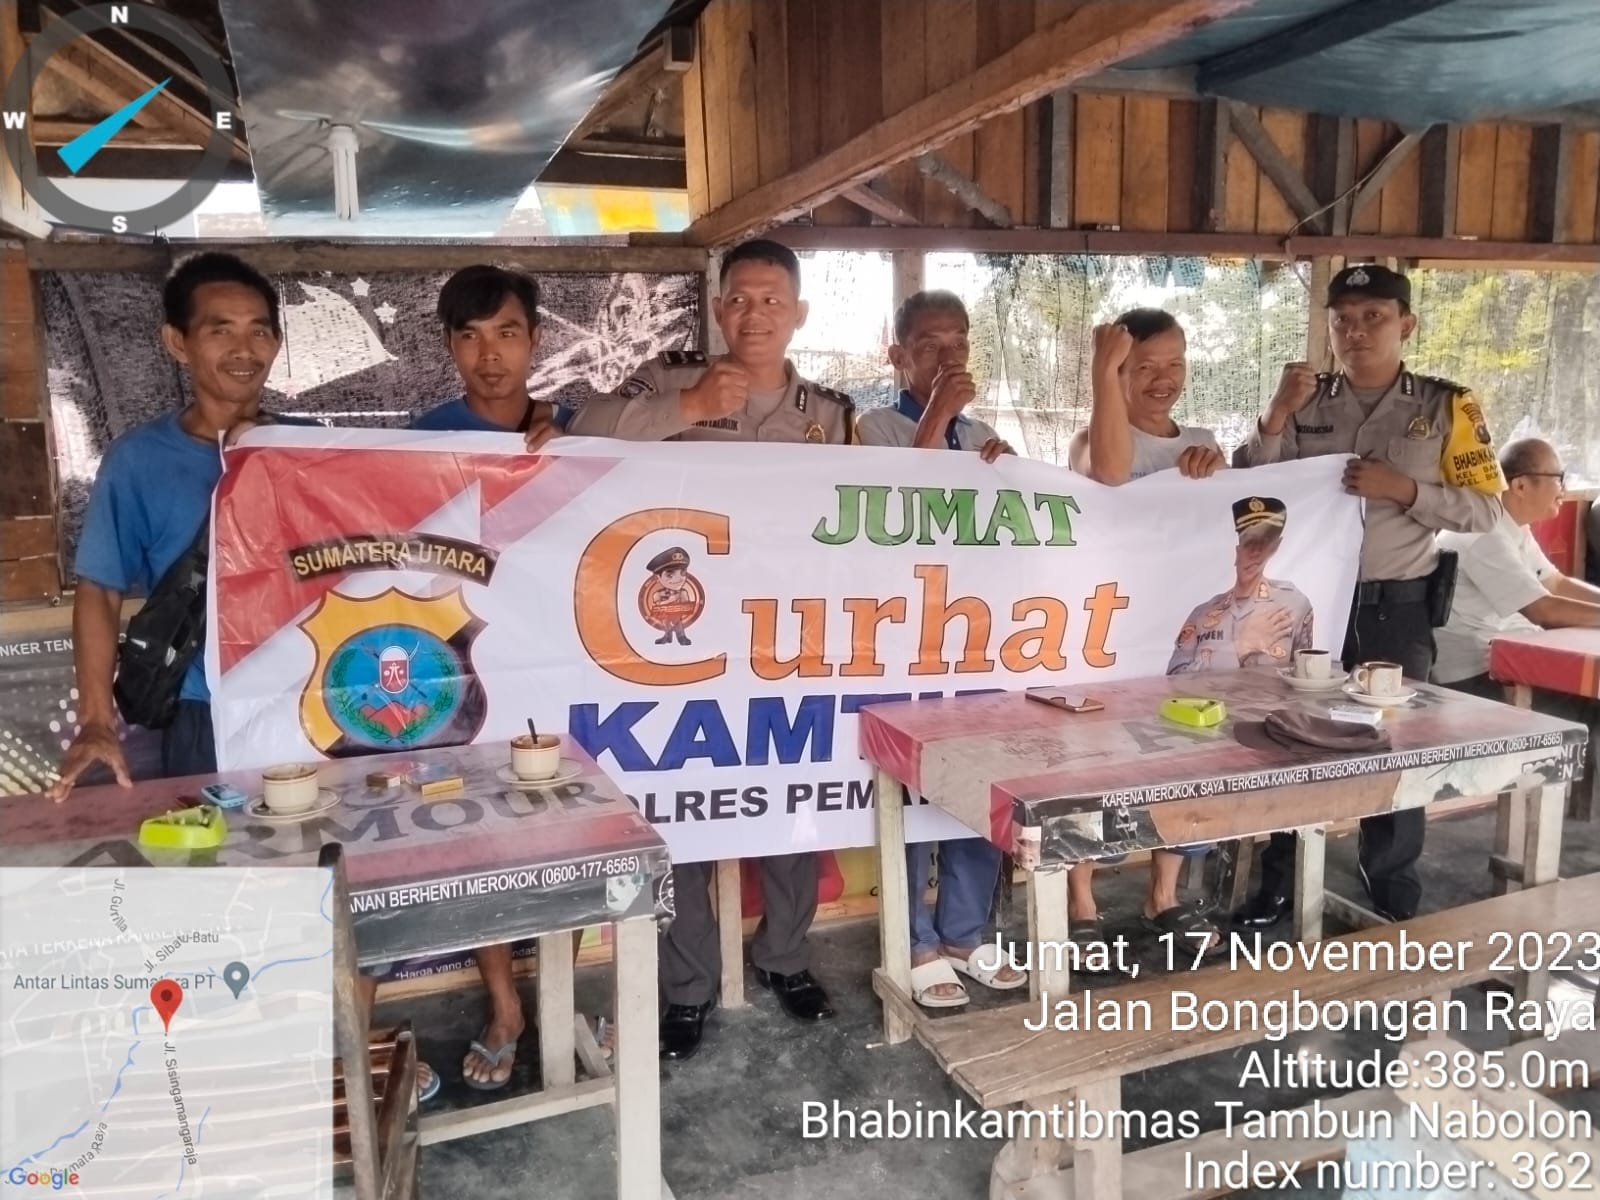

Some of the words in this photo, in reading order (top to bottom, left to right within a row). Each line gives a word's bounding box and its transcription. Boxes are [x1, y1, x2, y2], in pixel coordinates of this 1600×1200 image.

[812, 485, 1082, 547] JUMAT
[294, 542, 412, 576] SUMATERA
[419, 543, 486, 577] UTARA
[573, 507, 1130, 687] Curhat
[1102, 792, 1144, 808] KARENA
[1146, 783, 1198, 803] MEROKOK,
[1200, 780, 1225, 798] SAYA
[1226, 775, 1269, 793] TERKENA
[1270, 769, 1309, 786] KANKER
[1310, 761, 1379, 780] TENGGOROKAN
[1381, 755, 1420, 771] LAYANAN
[1421, 748, 1464, 765] BERHENTI
[1464, 740, 1505, 758] MEROKOK
[389, 879, 463, 908] BERHENTI
[466, 869, 538, 897] MEROKOK
[541, 855, 640, 888] (0600-177-6565)
